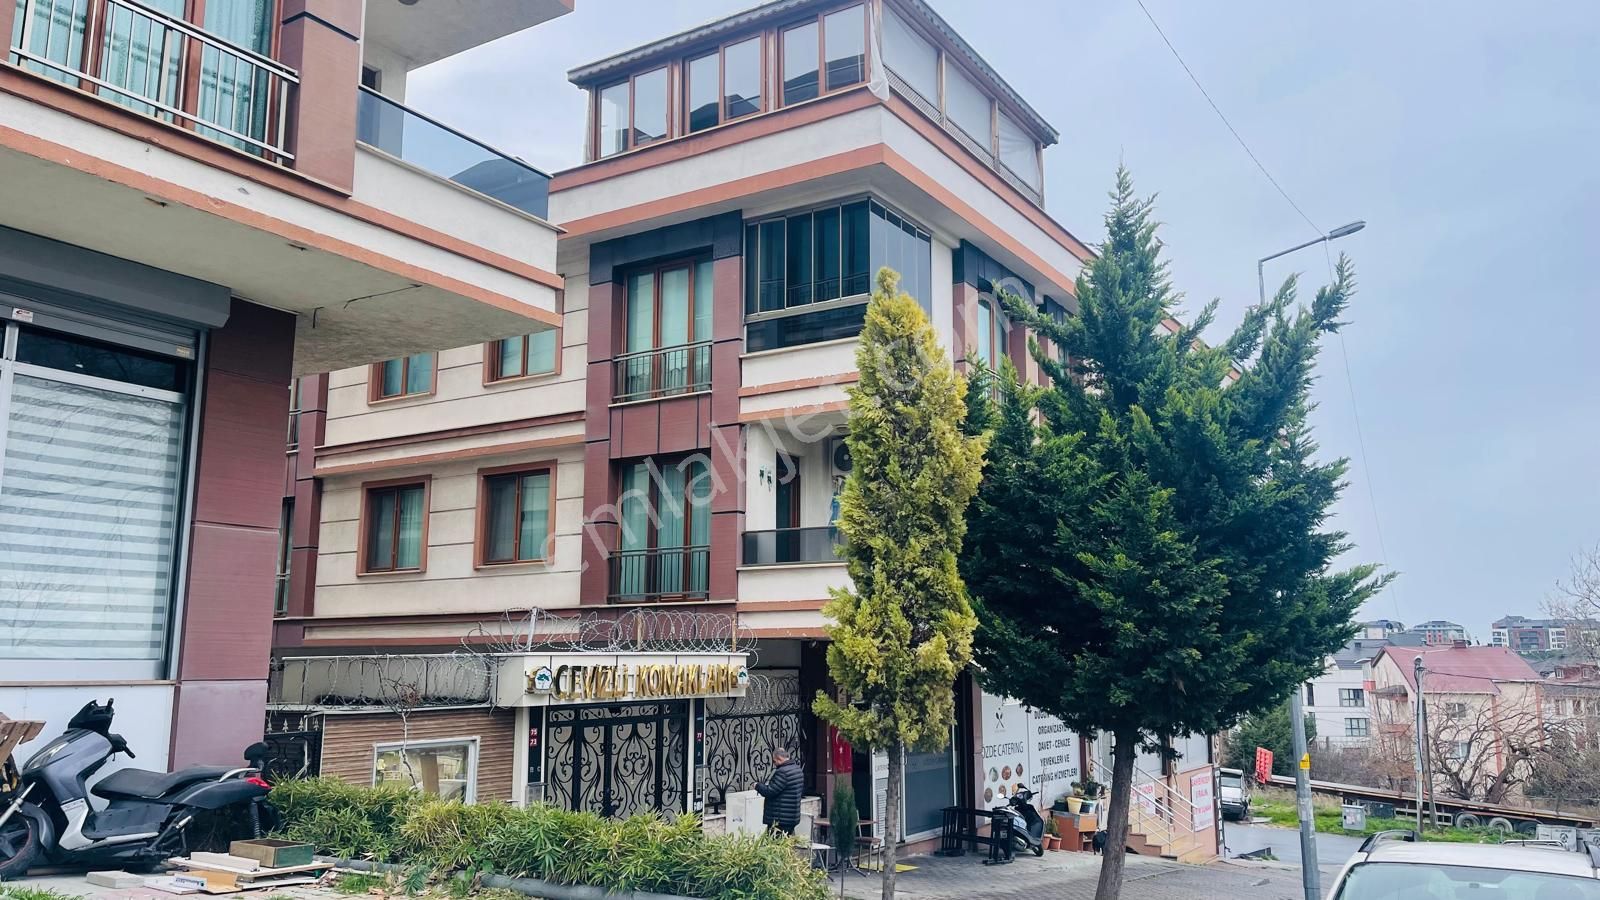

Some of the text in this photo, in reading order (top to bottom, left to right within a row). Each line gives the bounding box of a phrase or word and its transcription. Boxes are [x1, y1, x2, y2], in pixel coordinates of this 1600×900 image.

[997, 740, 1024, 757] CATERING
[1037, 740, 1052, 751] DAVET
[1054, 738, 1071, 749] CENAZE
[1032, 772, 1054, 785] CATERING
